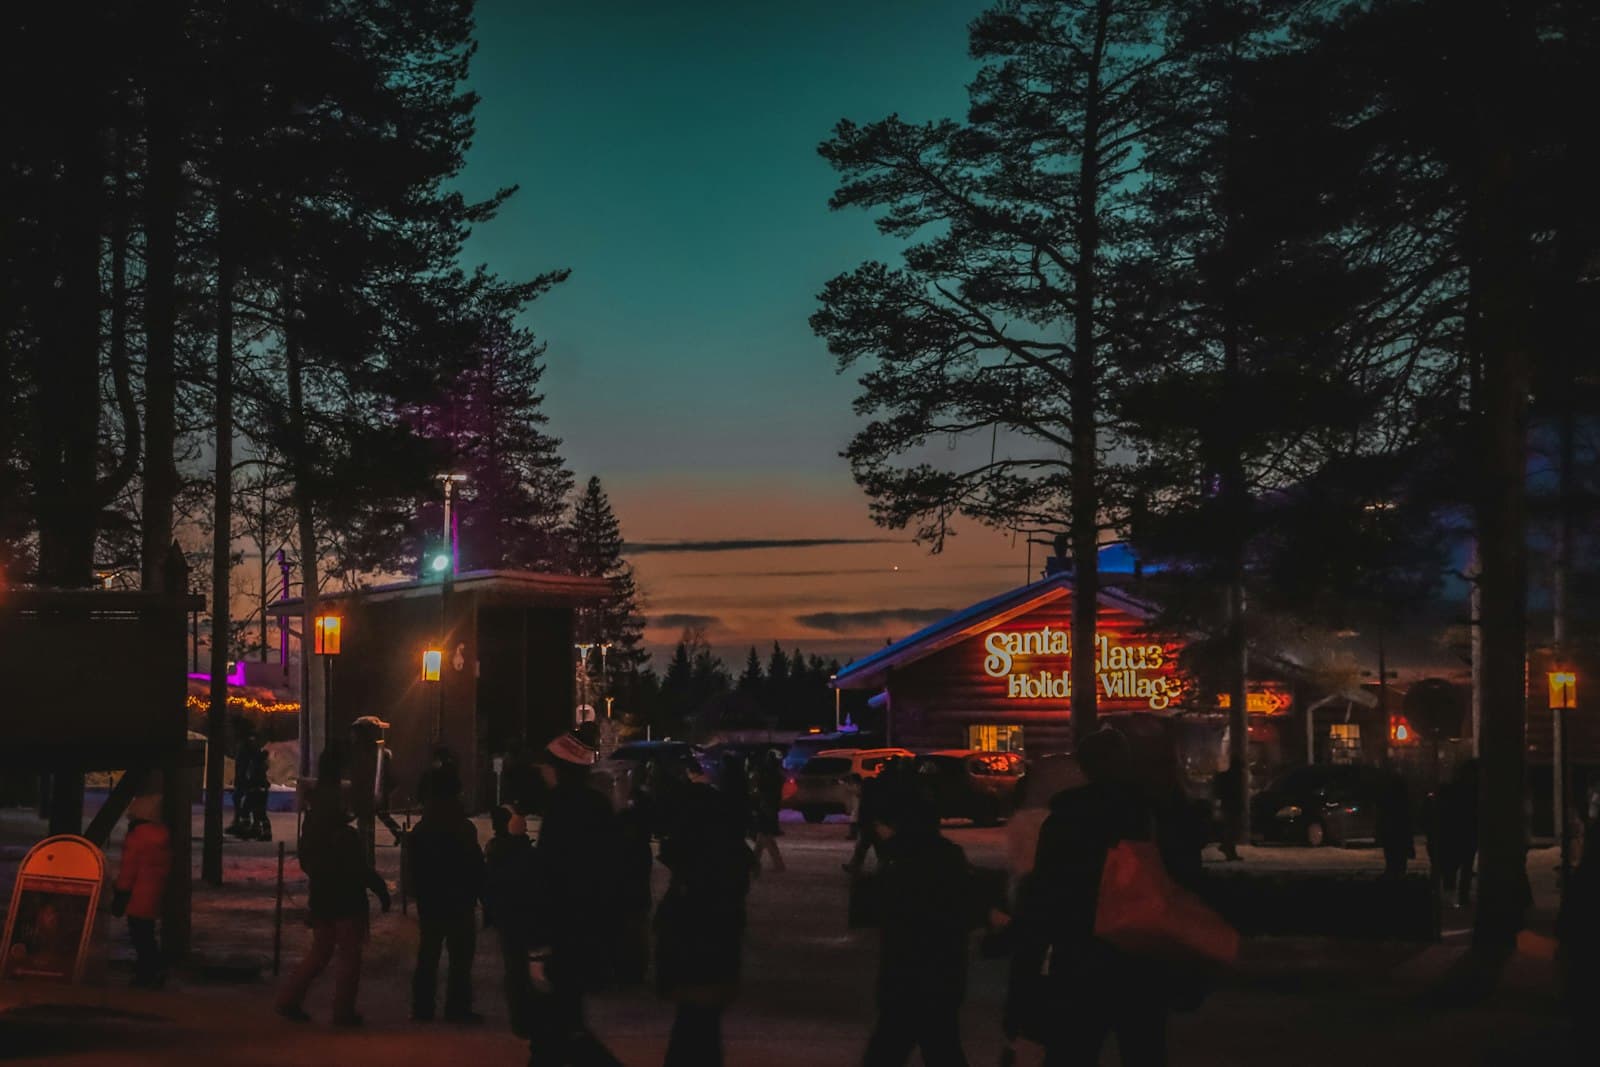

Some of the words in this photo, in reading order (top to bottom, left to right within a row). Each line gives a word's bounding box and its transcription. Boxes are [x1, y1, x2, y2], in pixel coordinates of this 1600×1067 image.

[985, 626, 1069, 676] Santa
[1008, 670, 1071, 698] Holid
[1100, 670, 1181, 710] Village
